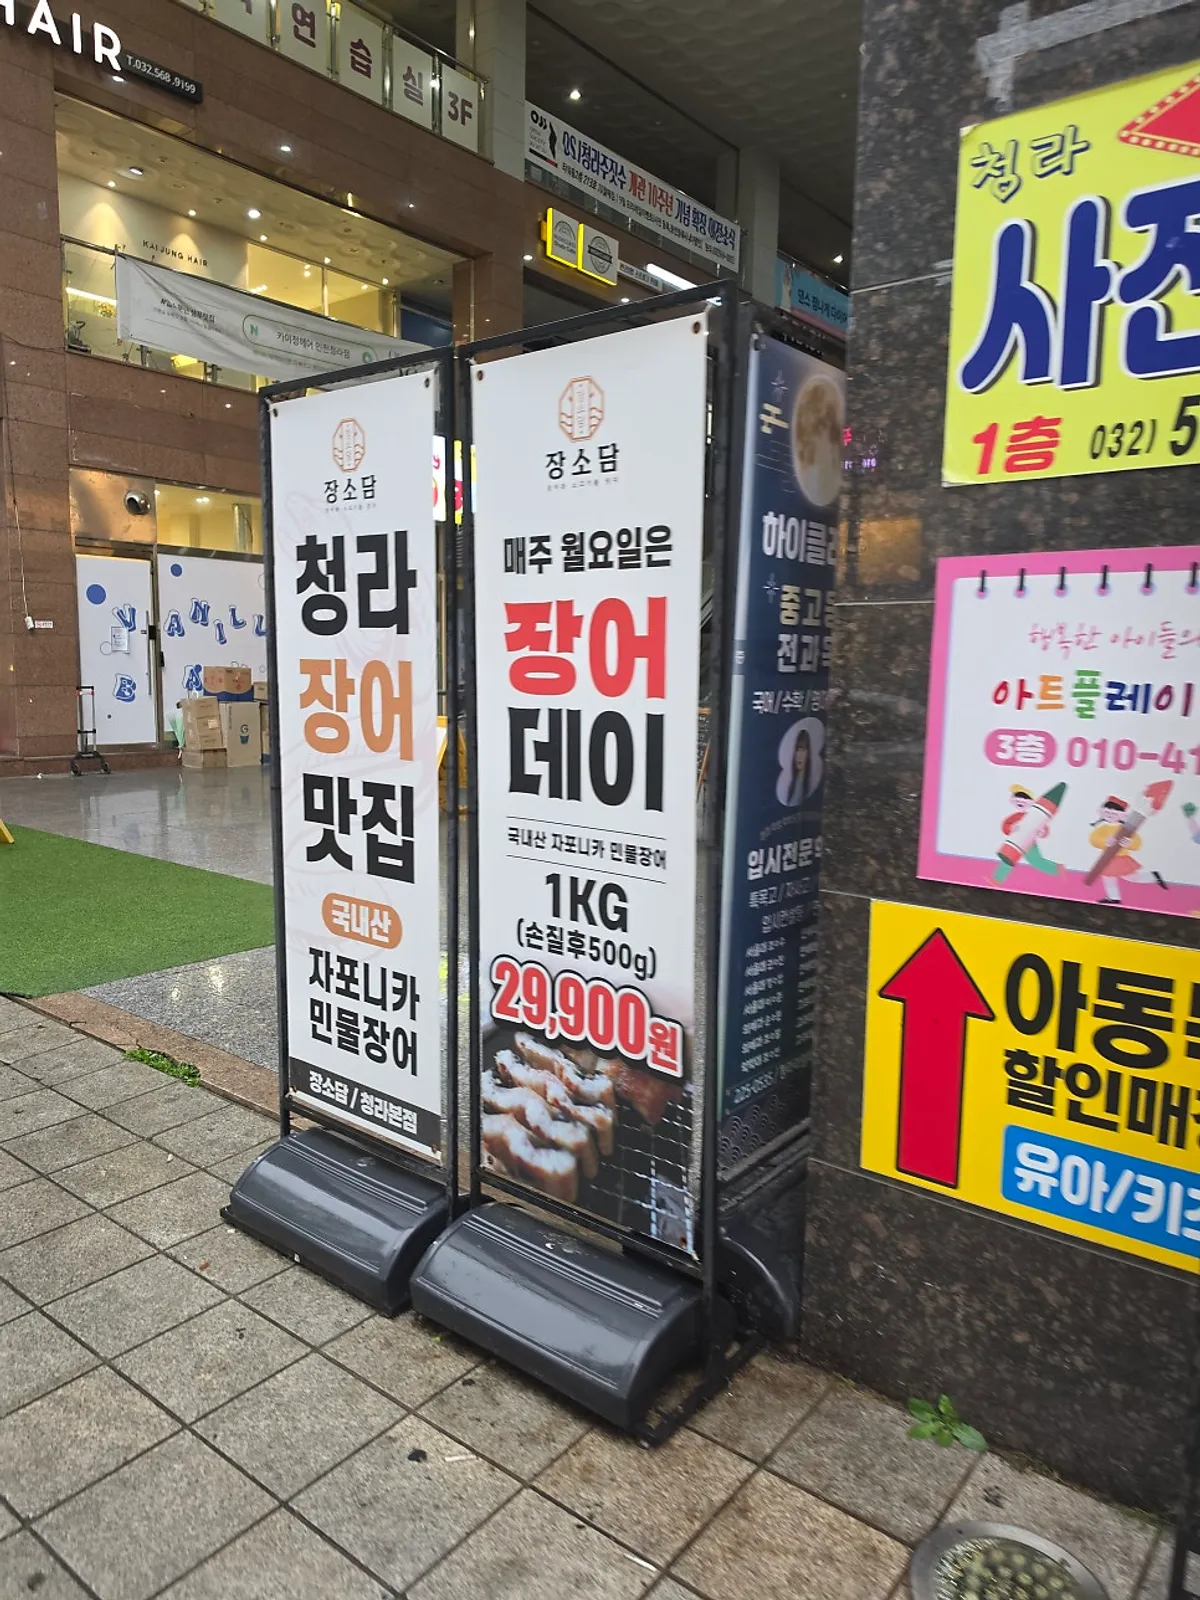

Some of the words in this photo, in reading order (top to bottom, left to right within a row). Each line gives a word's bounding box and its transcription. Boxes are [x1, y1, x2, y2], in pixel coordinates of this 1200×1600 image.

[447, 91, 473, 126] 3F
[970, 124, 1091, 203] 청라
[142, 240, 160, 255] KAI
[160, 246, 184, 259] JUNG
[187, 252, 208, 266] HAIR
[545, 443, 619, 480] 장소담
[972, 415, 1063, 475] 1층
[1090, 418, 1157, 459] 032)
[324, 474, 377, 504] 장소담
[503, 535, 553, 575] 매주
[560, 524, 673, 573] 월요일은
[296, 530, 418, 636] 청라
[504, 597, 667, 699] 장어
[1029, 622, 1102, 660] 행복한
[299, 658, 414, 762] 장어
[991, 669, 1195, 720] 아트플레이
[507, 706, 665, 813] 데이
[995, 733, 1046, 763] 3층
[303, 773, 415, 884] 맛집
[508, 827, 547, 850] 국내산
[551, 833, 605, 859] 자포니카
[609, 841, 667, 870] 민물장어
[331, 899, 391, 943] 국내산
[545, 873, 629, 933] 1KG
[517, 917, 657, 982] (손질후500g)
[309, 946, 420, 1021] 자포니카
[491, 956, 683, 1076] 29,900원
[1004, 952, 1200, 1070] 아동
[309, 997, 418, 1077] 민물장어
[309, 1069, 349, 1107] 장소담
[360, 1091, 418, 1136] 청라본점
[1003, 1048, 1200, 1150] 할인매
